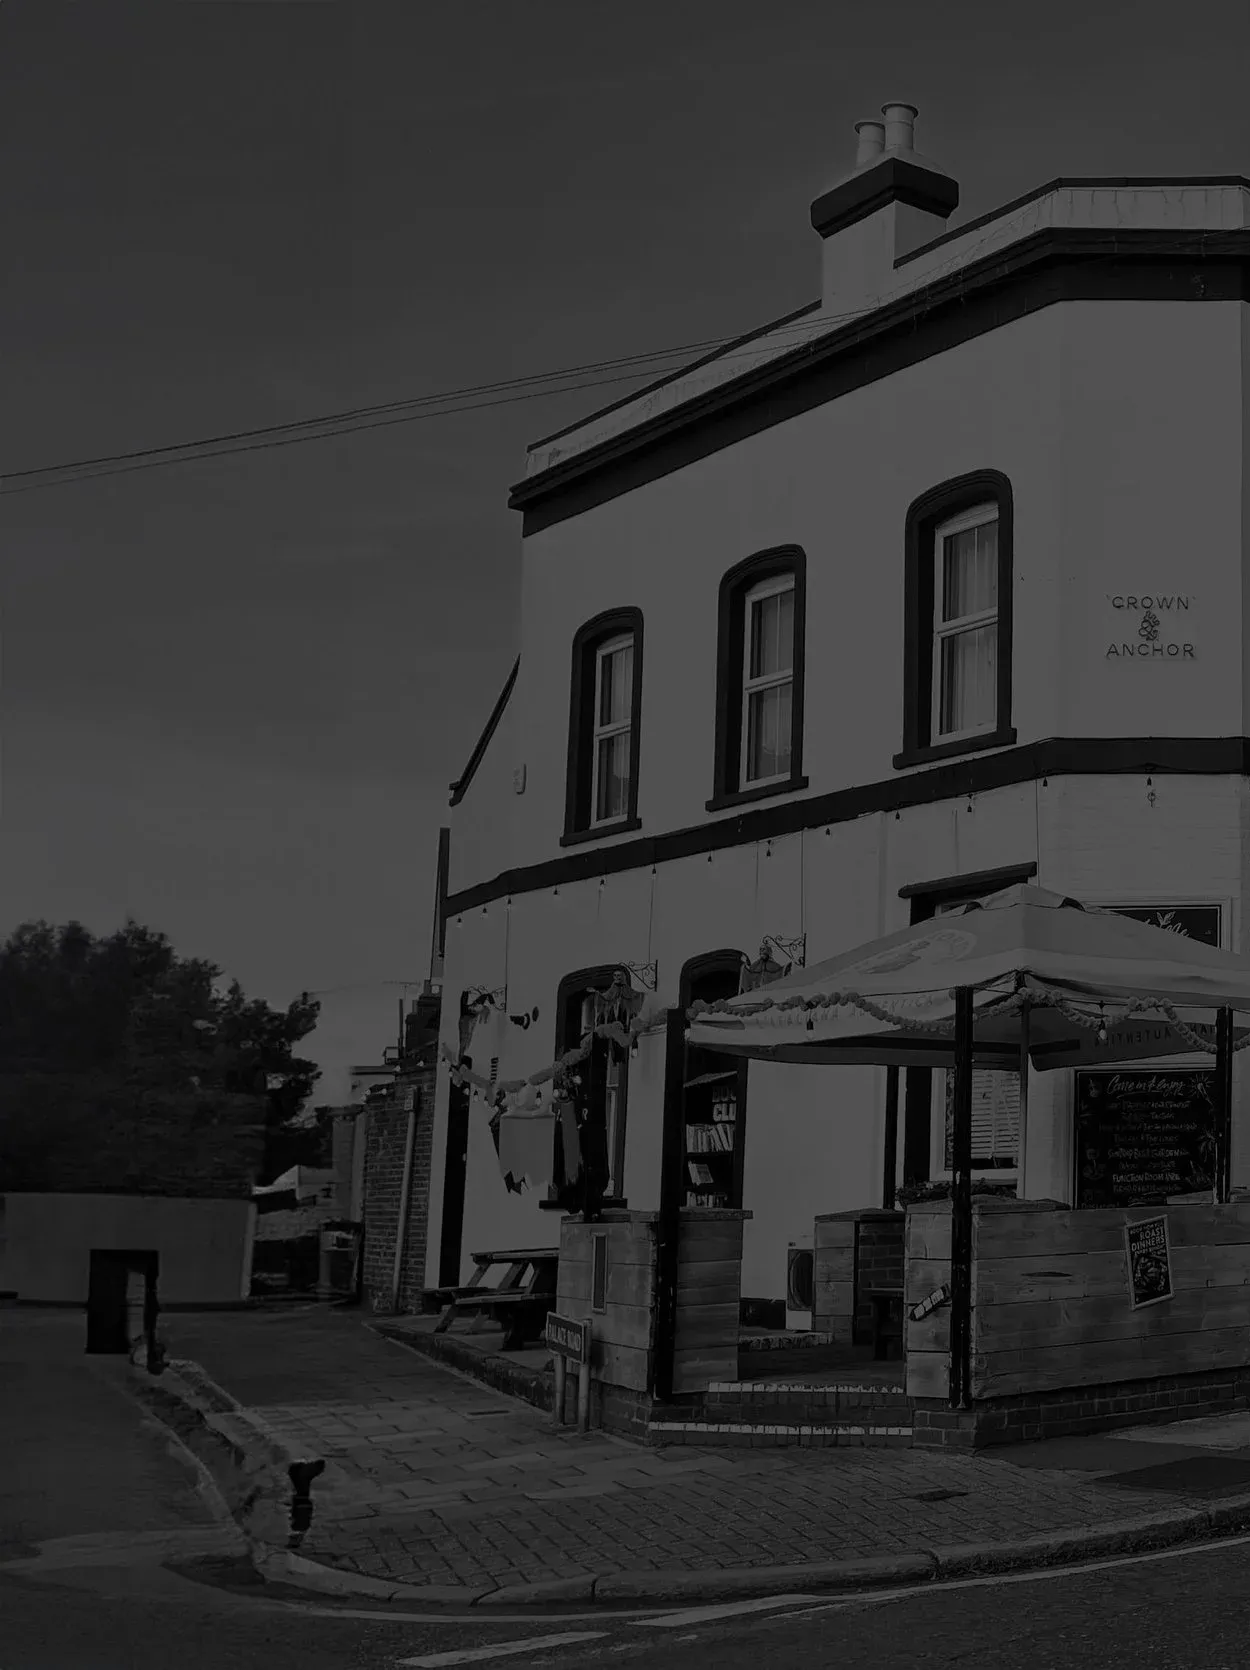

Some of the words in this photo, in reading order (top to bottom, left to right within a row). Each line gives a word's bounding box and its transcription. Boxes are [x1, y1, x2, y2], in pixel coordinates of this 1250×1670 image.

[1111, 596, 1189, 610] CROWN
[1106, 643, 1195, 659] ANCHOR
[1139, 1226, 1164, 1241] ROAST
[1131, 1236, 1165, 1252] DINNERS
